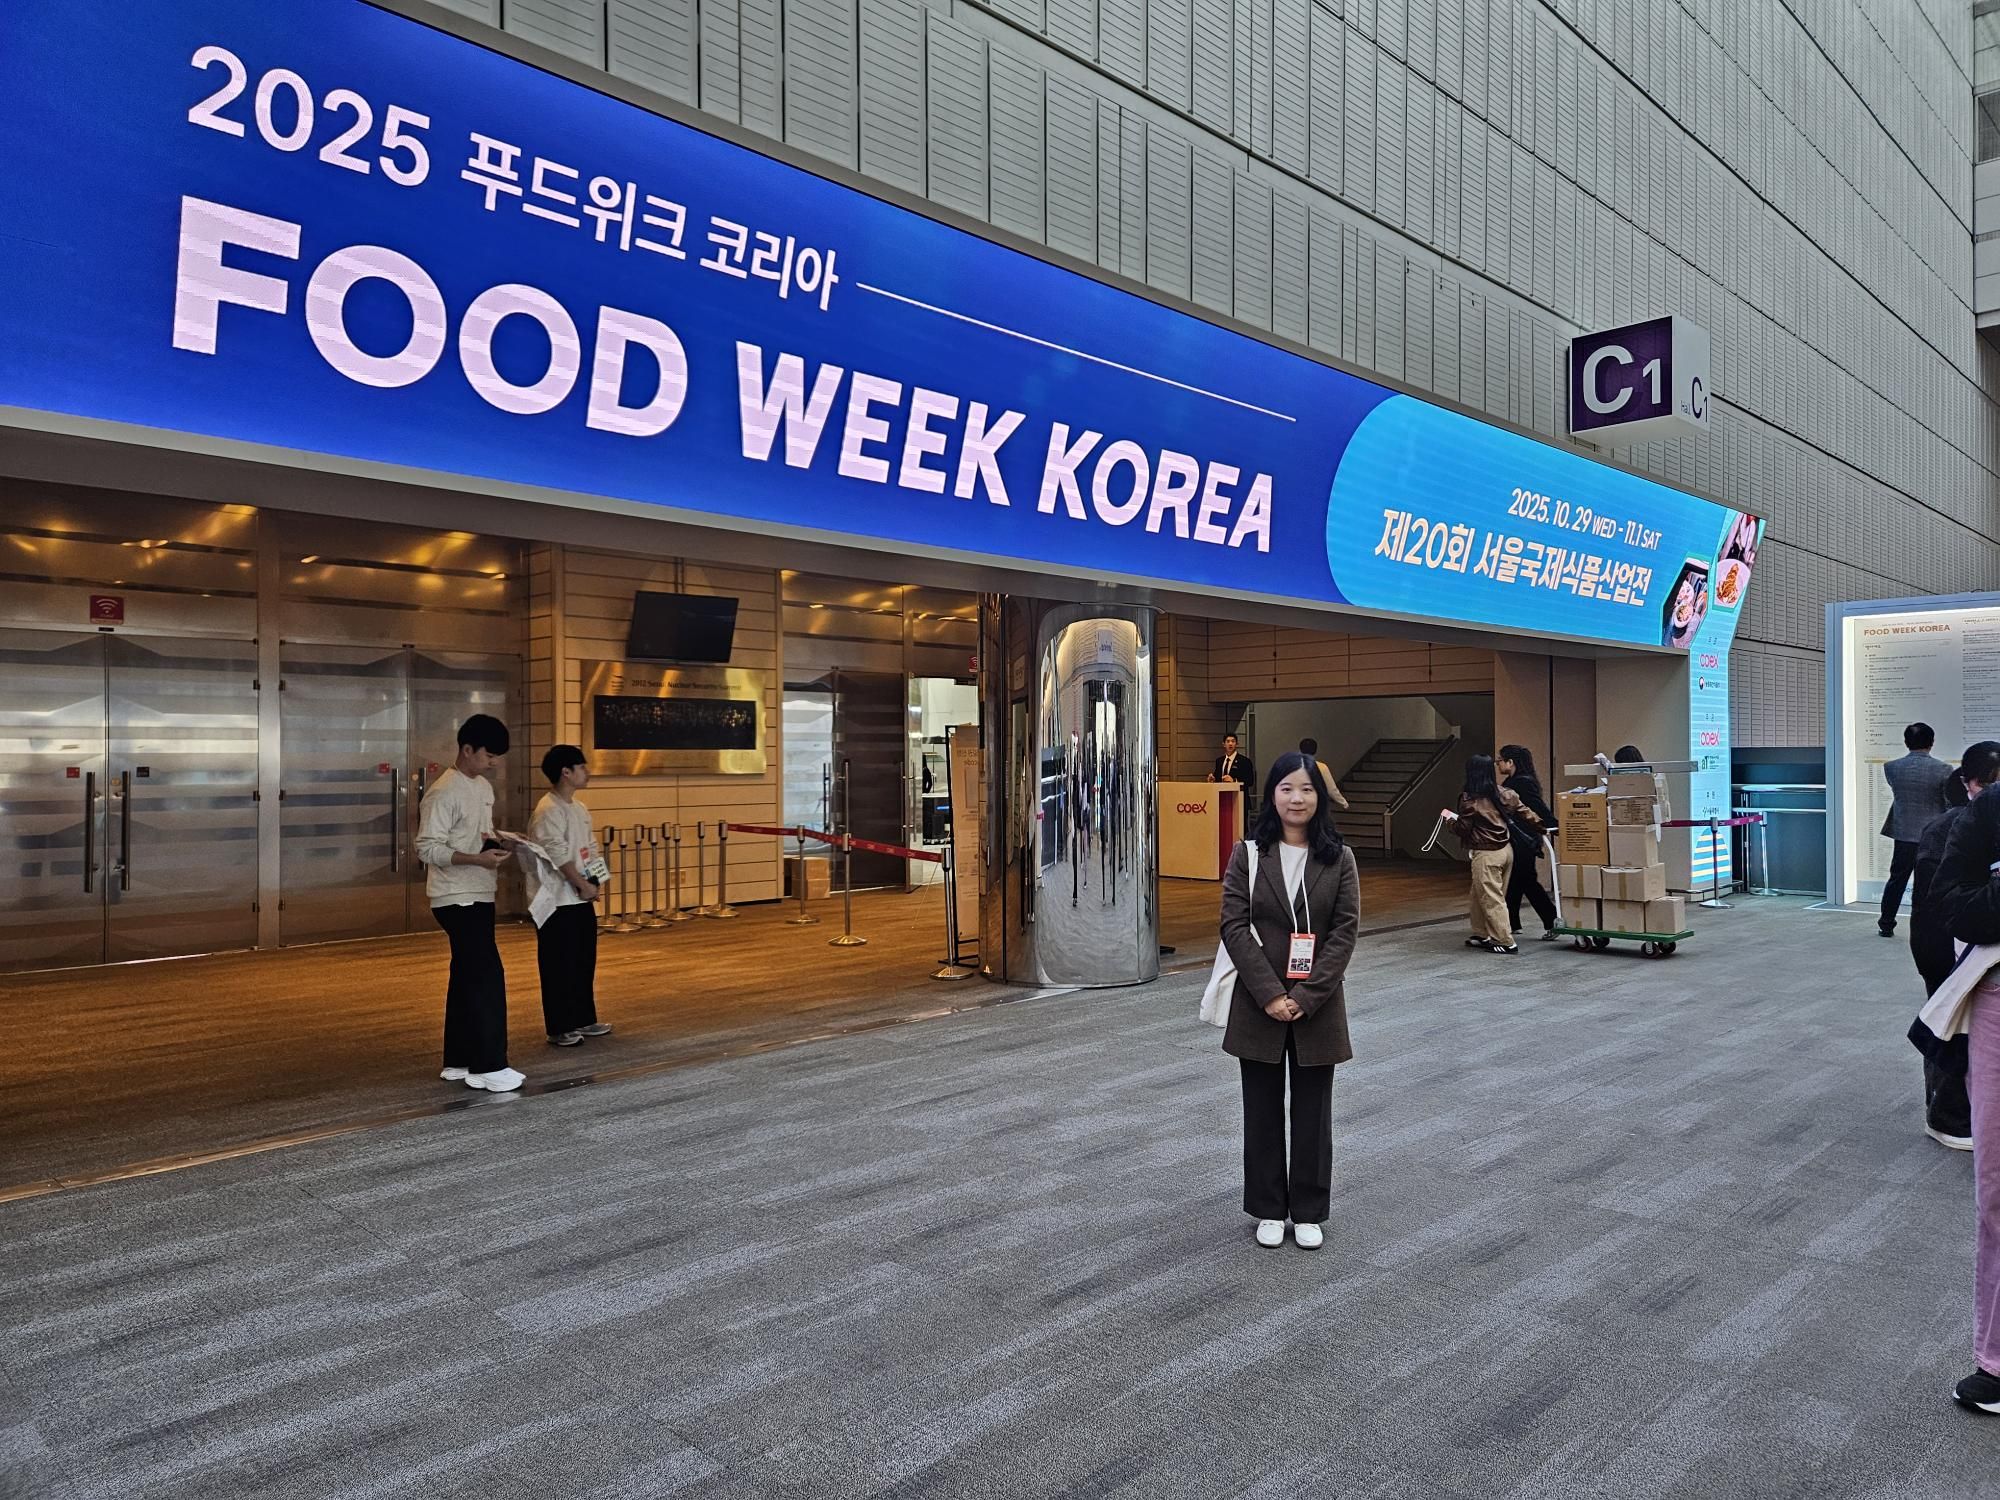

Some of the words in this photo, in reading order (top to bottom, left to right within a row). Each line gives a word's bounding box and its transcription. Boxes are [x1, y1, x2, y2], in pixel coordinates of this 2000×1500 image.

[188, 45, 431, 187] 2025
[460, 131, 687, 261] 푸드위크
[700, 214, 840, 311] 코리아
[172, 194, 689, 437] FOOD
[735, 340, 1027, 506] WEEK
[1036, 420, 1274, 553] KOREA
[1582, 345, 1662, 414] C1
[1691, 376, 1708, 423] C1
[1507, 487, 1550, 524] 2025.
[1552, 500, 1570, 529] 10.
[1571, 505, 1593, 533] 29
[1592, 514, 1617, 539] WED
[1624, 520, 1643, 547] 11.1
[1641, 529, 1663, 551] SAT
[1374, 508, 1475, 573] 제20회
[1473, 531, 1652, 607] 서울국제식품산업전
[1863, 628, 1890, 637] FOOD
[1892, 626, 1917, 635] WEEK
[1919, 624, 1951, 633] KOREA
[1700, 728, 1720, 746] coex
[1176, 800, 1207, 814] coex
